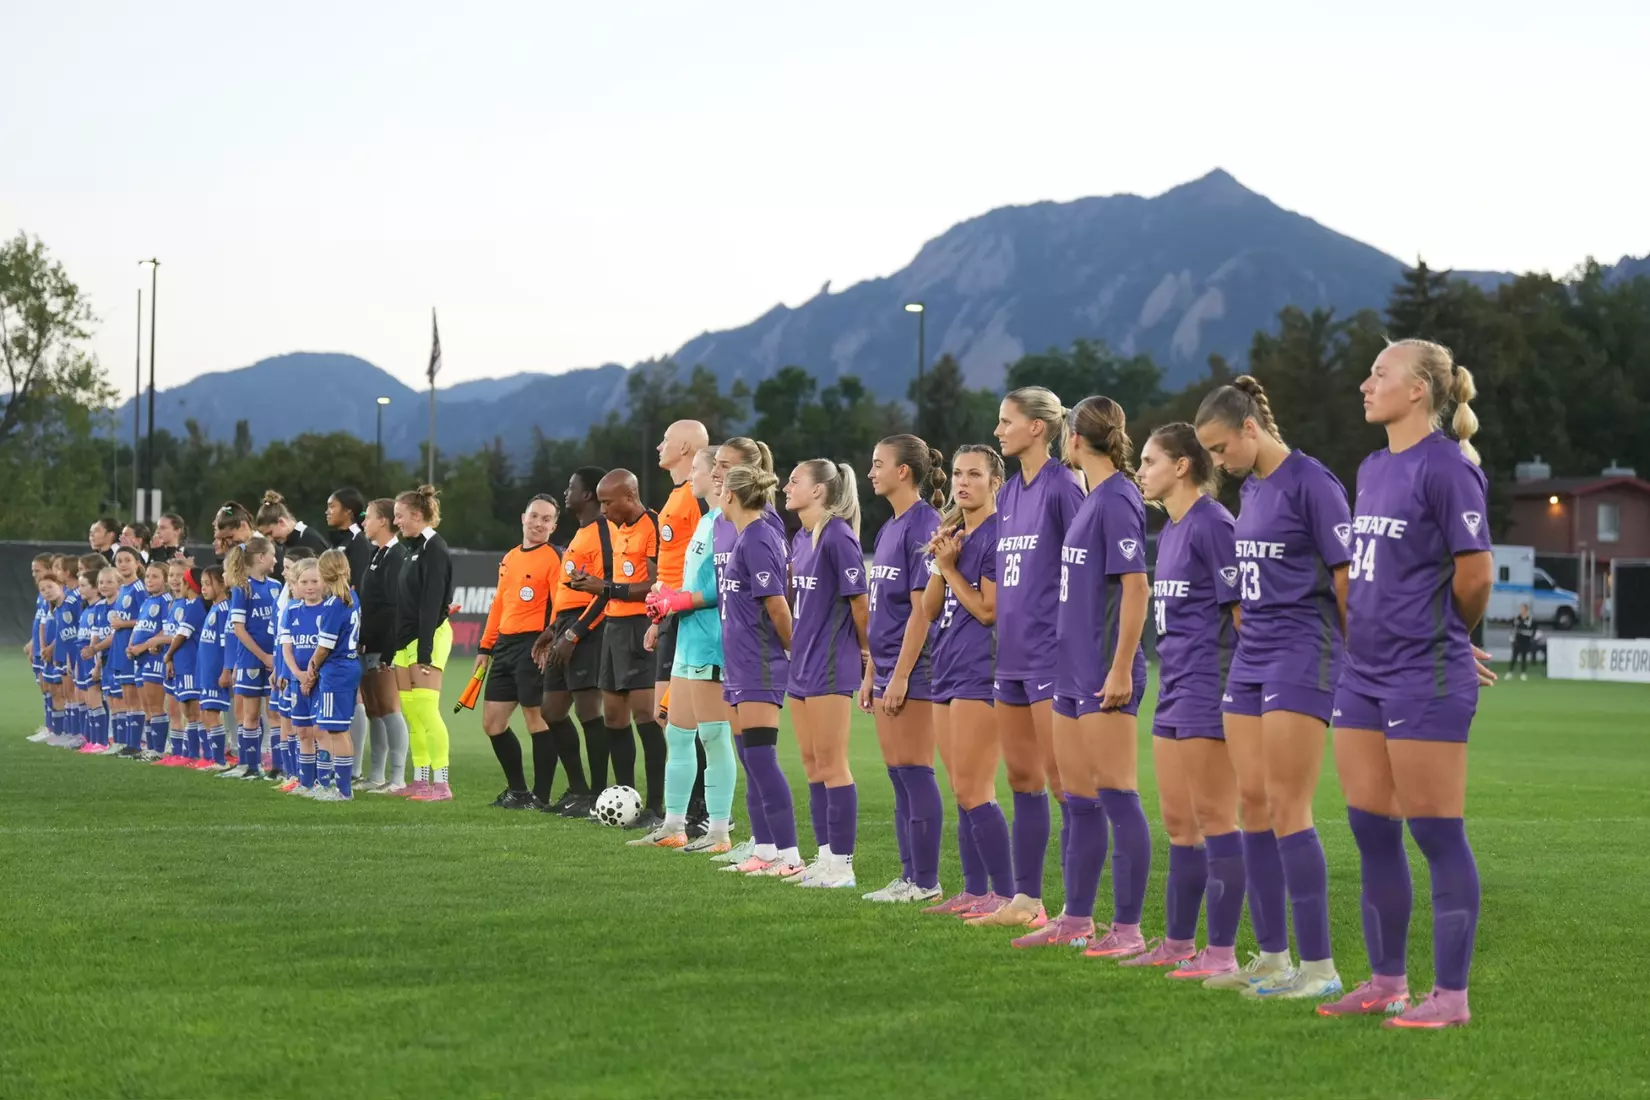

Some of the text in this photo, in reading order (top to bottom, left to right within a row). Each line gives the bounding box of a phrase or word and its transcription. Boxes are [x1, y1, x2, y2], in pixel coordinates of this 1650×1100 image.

[997, 535, 1039, 551] K-STATE
[1235, 540, 1286, 559] STATE
[1003, 552, 1021, 587] 26
[1348, 537, 1376, 581] 34
[1610, 648, 1650, 672] BEFOR
